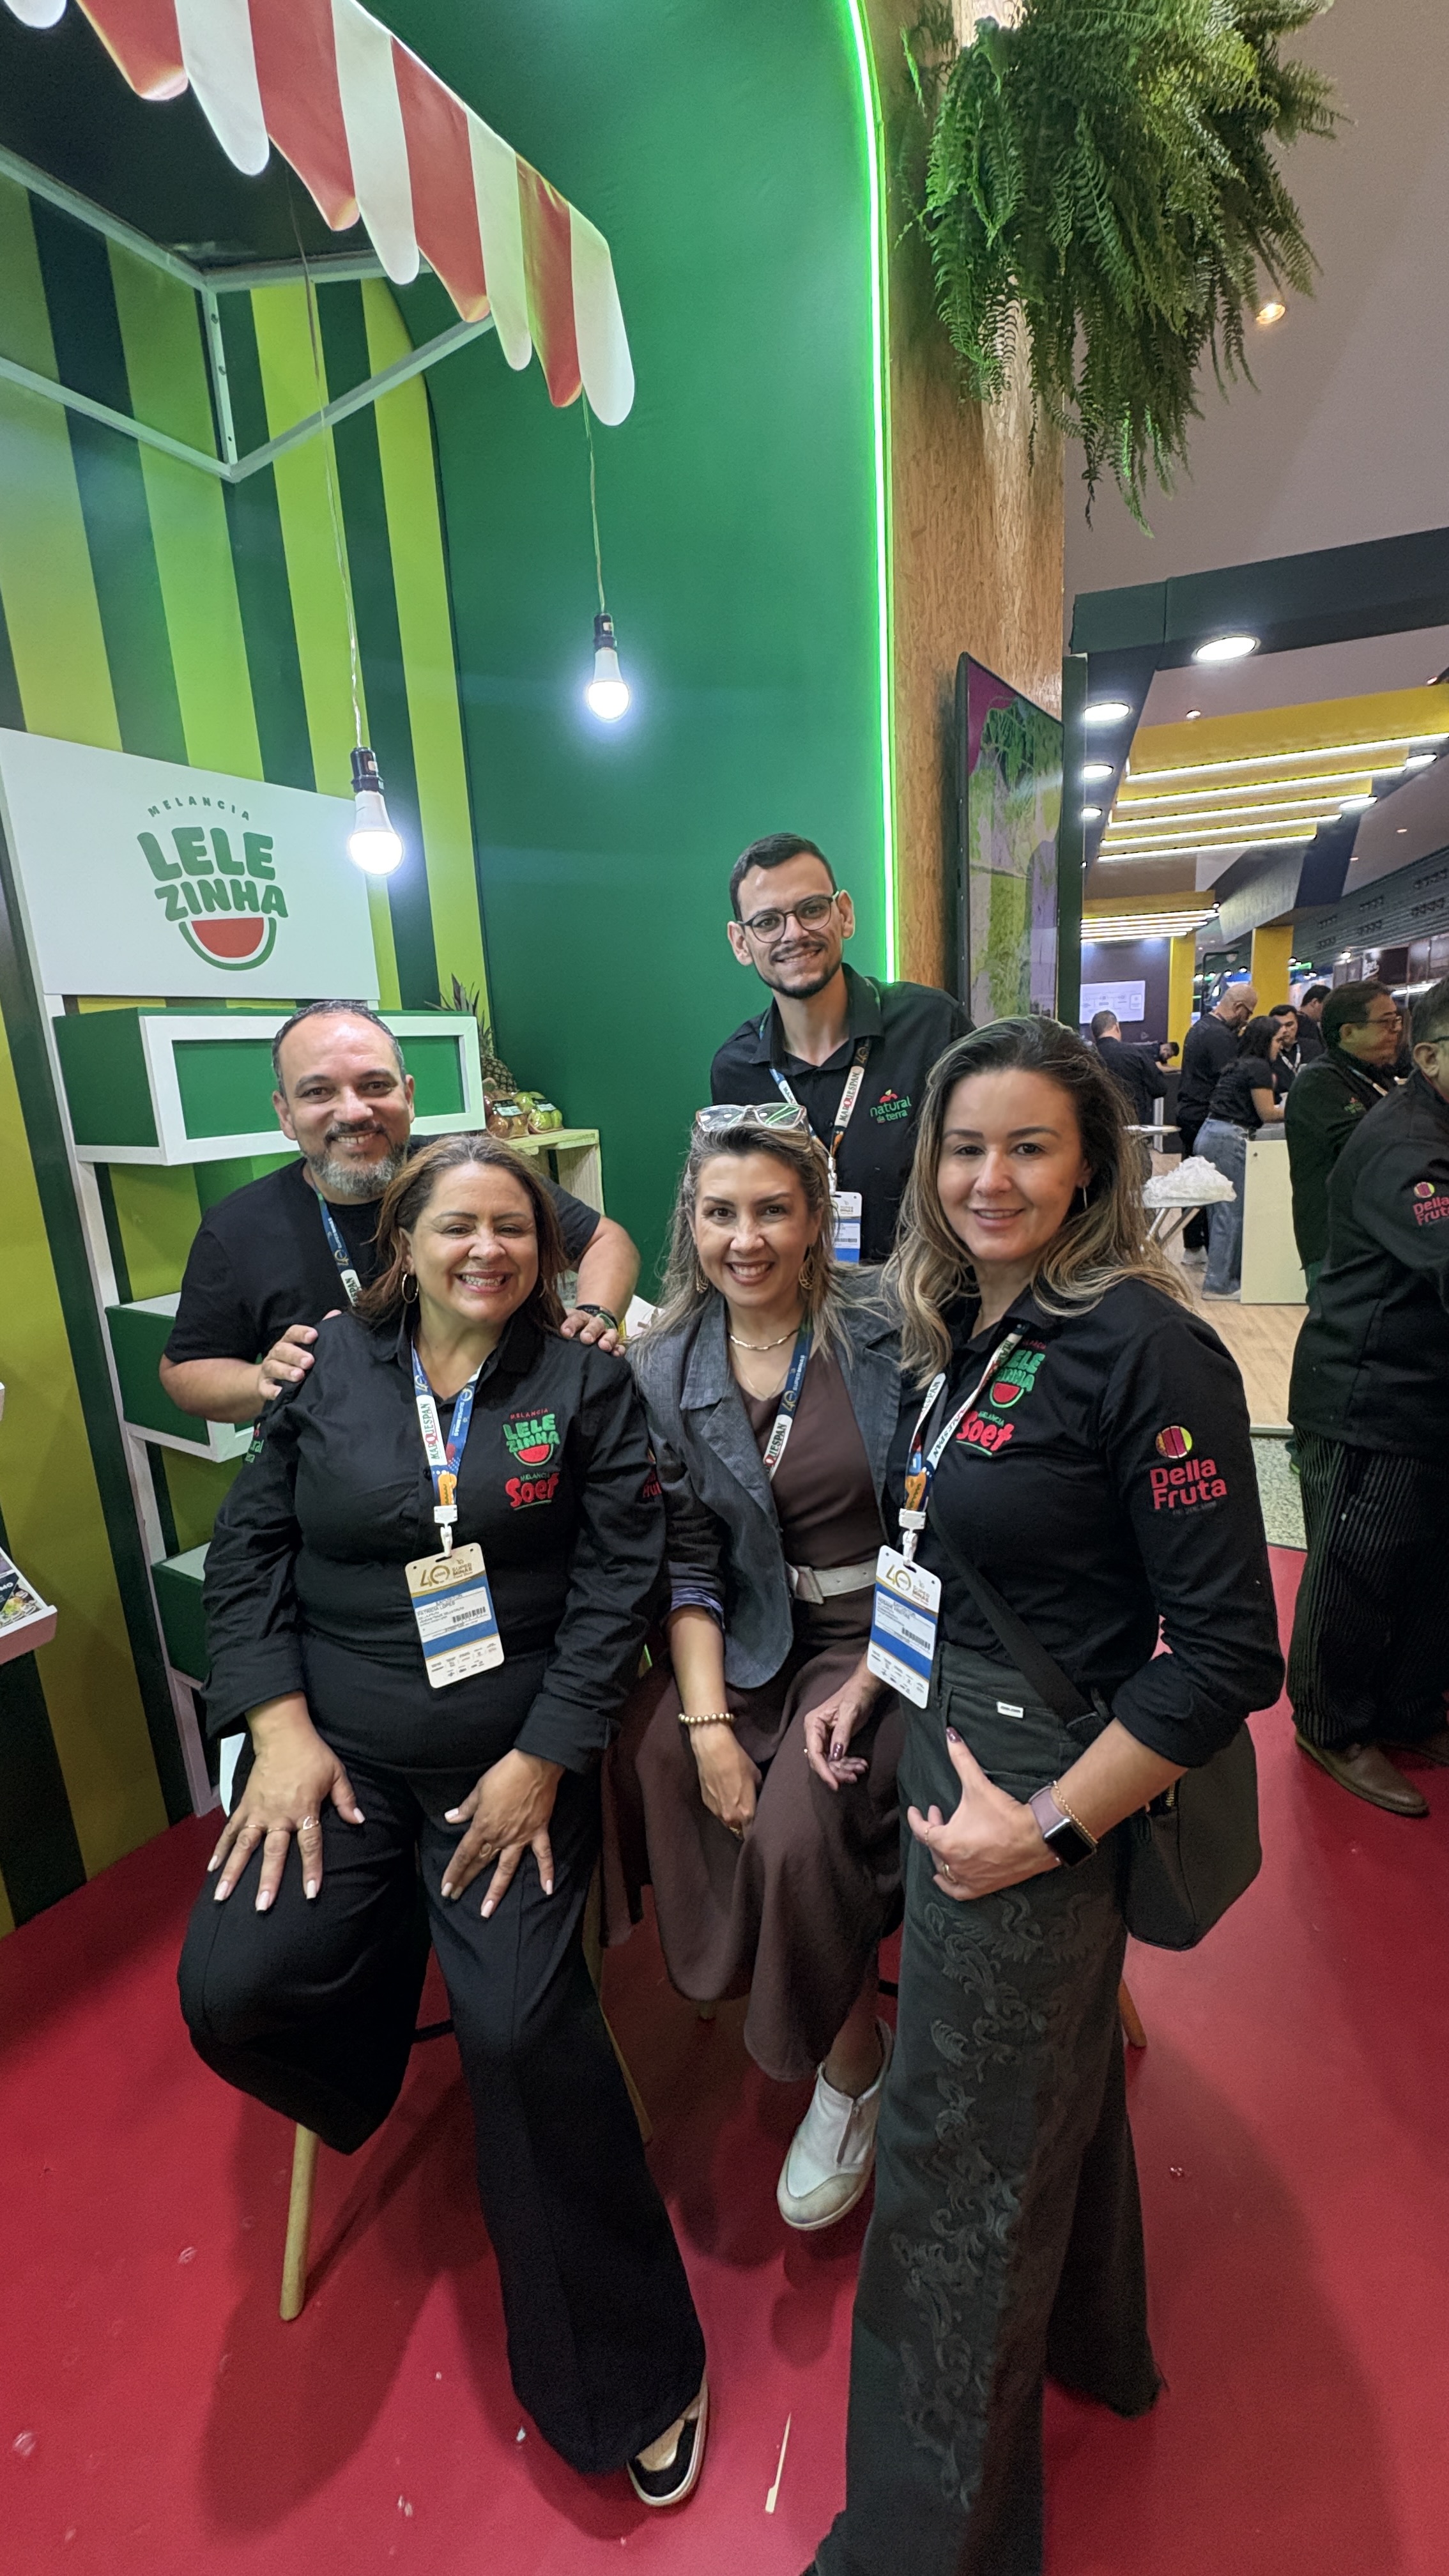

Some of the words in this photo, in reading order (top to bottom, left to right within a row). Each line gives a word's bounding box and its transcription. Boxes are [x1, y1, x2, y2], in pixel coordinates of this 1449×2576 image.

[148, 796, 250, 821] MELANCIA
[137, 827, 275, 882] LELE
[155, 878, 289, 921] ZINHA
[838, 1071, 860, 1123] MARQUESPAN
[870, 1096, 912, 1117] natural
[885, 1110, 908, 1121] terra
[1413, 1197, 1449, 1215] Della
[1416, 1207, 1449, 1226] Frut
[1005, 1349, 1046, 1374] ELE
[997, 1368, 1035, 1392] INHA
[503, 1413, 556, 1440] LELE
[510, 1408, 549, 1420] MELANCIA
[420, 1403, 440, 1460] MARQUESPAN
[506, 1431, 560, 1453] ZINHA
[764, 1423, 788, 1468] QUESPAN
[1150, 1459, 1217, 1489] Della
[1153, 1478, 1227, 1510] Fruta
[420, 1565, 450, 1587] 40
[886, 1564, 911, 1591] 40
